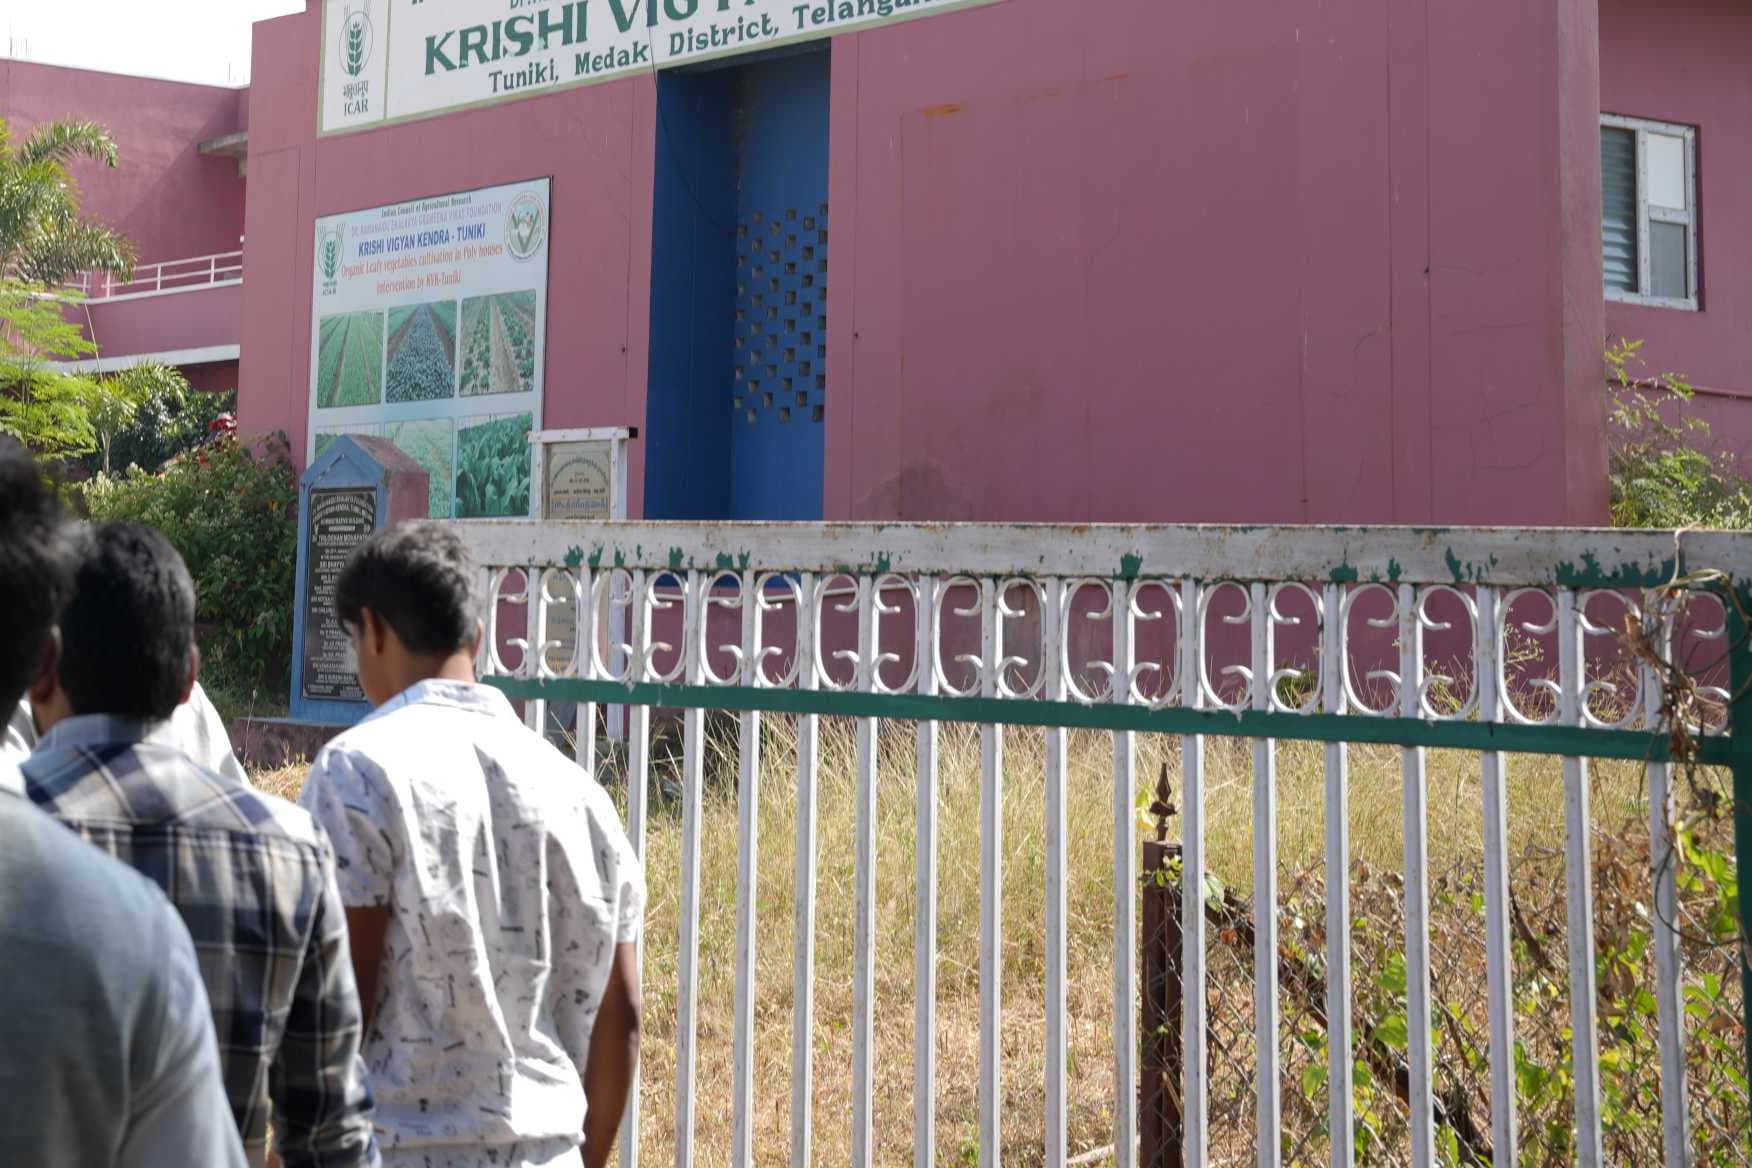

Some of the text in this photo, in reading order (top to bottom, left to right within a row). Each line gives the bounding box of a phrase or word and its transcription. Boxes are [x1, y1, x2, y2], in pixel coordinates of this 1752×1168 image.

[424, 0, 589, 76] KRISHI
[489, 58, 560, 93] Tuniki,
[574, 40, 649, 76] Medak
[669, 13, 779, 57] District,
[344, 98, 368, 116] ICAR
[359, 238, 384, 257] KRISHI
[386, 233, 416, 252] VIGYAN
[417, 229, 450, 247] KENDRA
[456, 223, 486, 242] TUNIKI
[384, 254, 417, 273] vegetables
[418, 247, 453, 265] cultivation
